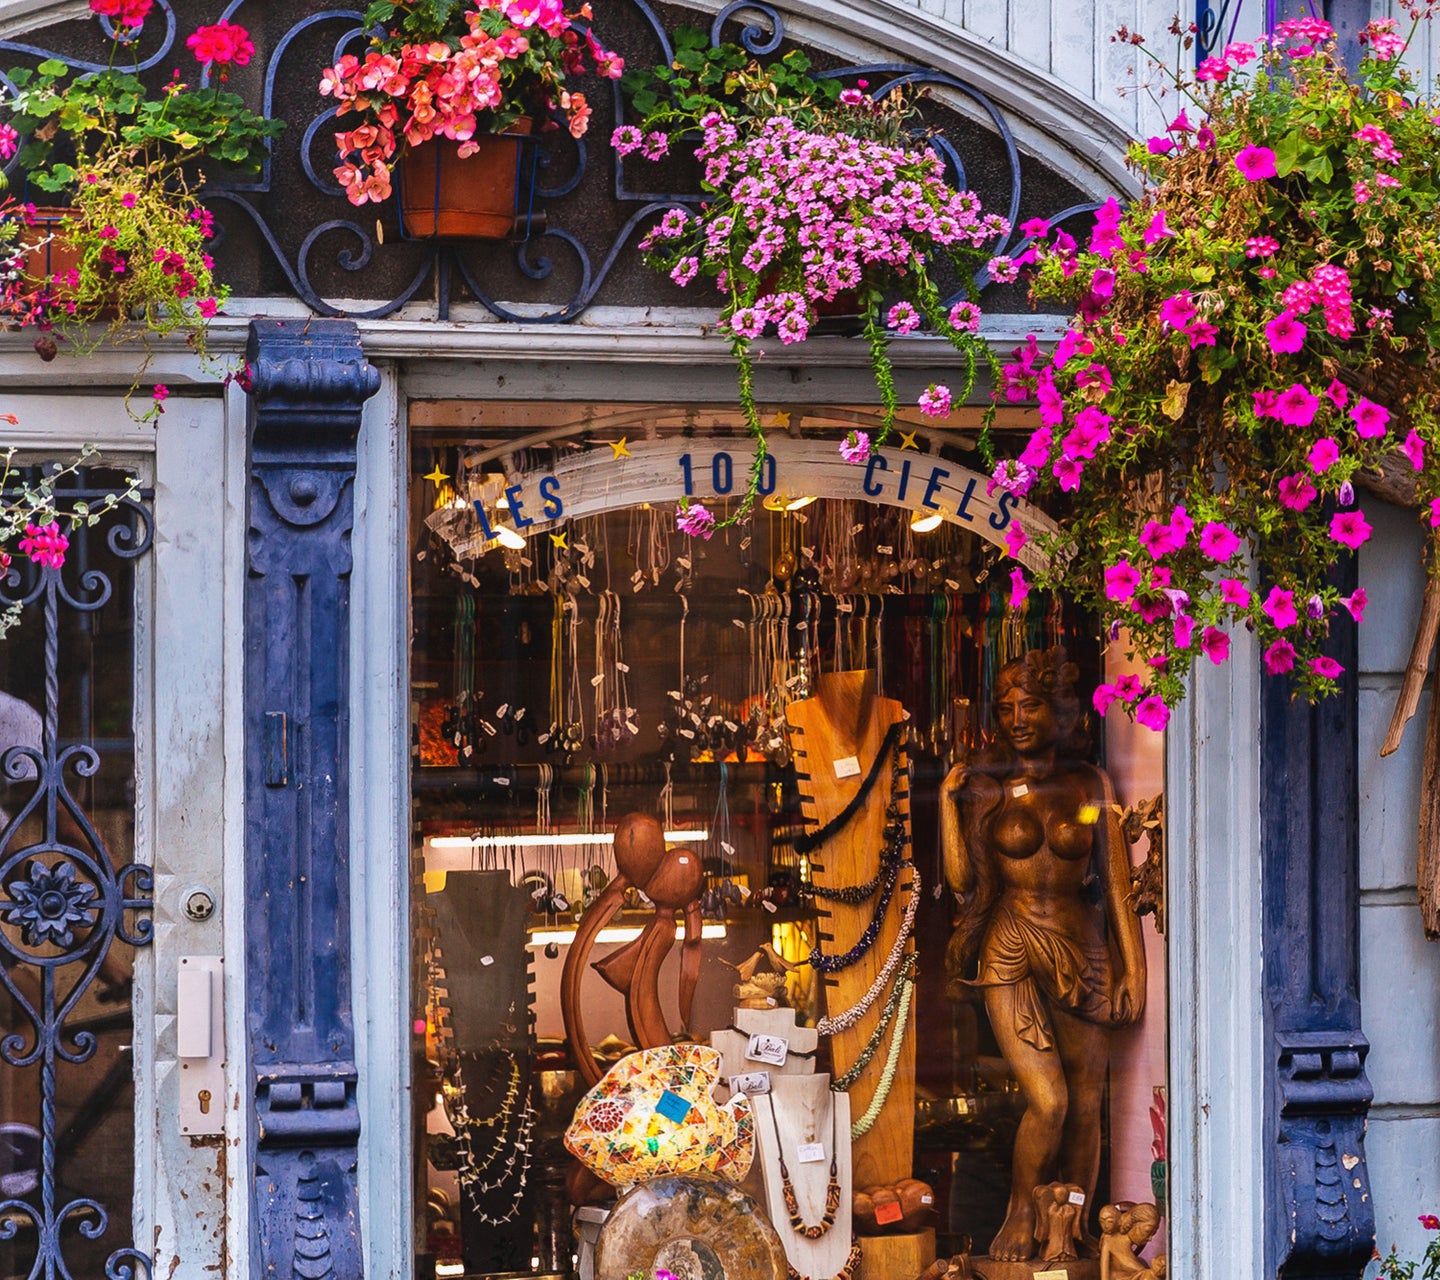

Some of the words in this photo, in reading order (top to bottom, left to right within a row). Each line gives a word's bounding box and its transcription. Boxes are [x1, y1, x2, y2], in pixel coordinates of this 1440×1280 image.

[473, 476, 564, 541] LES
[678, 452, 777, 496] 100
[863, 454, 1019, 530] CIELS
